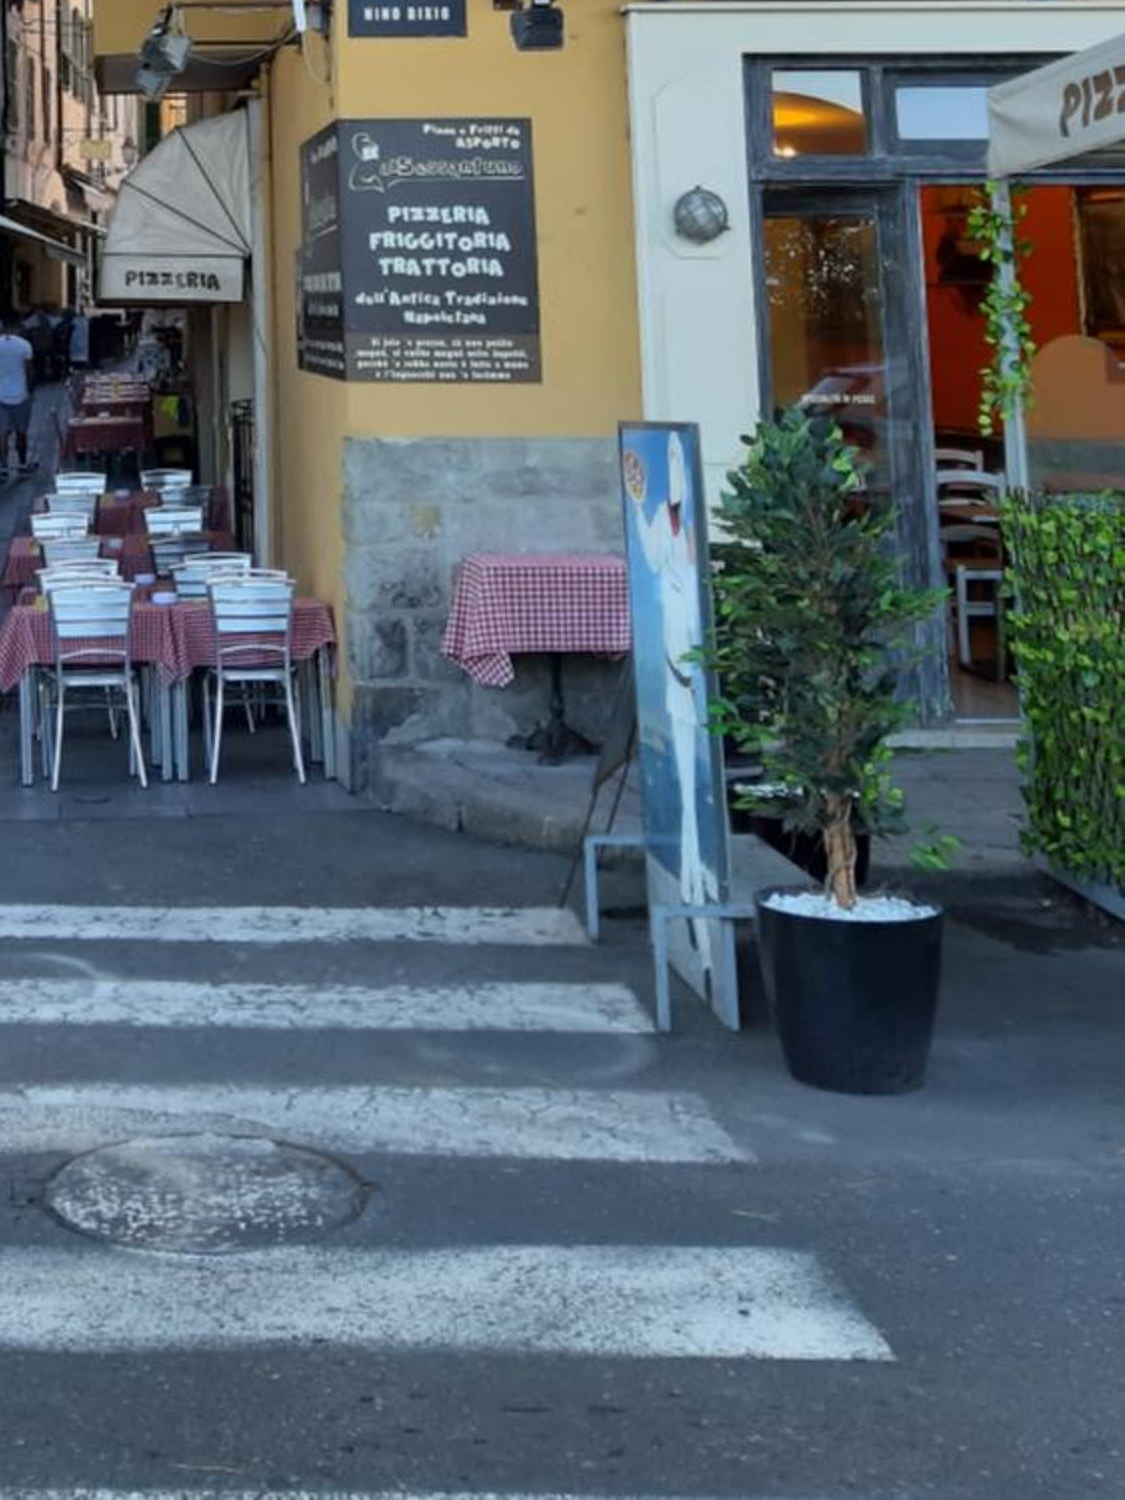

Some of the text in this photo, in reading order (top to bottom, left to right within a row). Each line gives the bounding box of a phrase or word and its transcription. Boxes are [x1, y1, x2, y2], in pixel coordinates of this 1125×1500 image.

[364, 6, 450, 21] NINO BIXIO
[455, 136, 521, 149] ASPORTO
[387, 204, 491, 225] PIZZERIA
[368, 230, 511, 251] FRIGGITORIA
[378, 256, 504, 277] TRATTORIA
[125, 270, 220, 292] PIZZERIA
